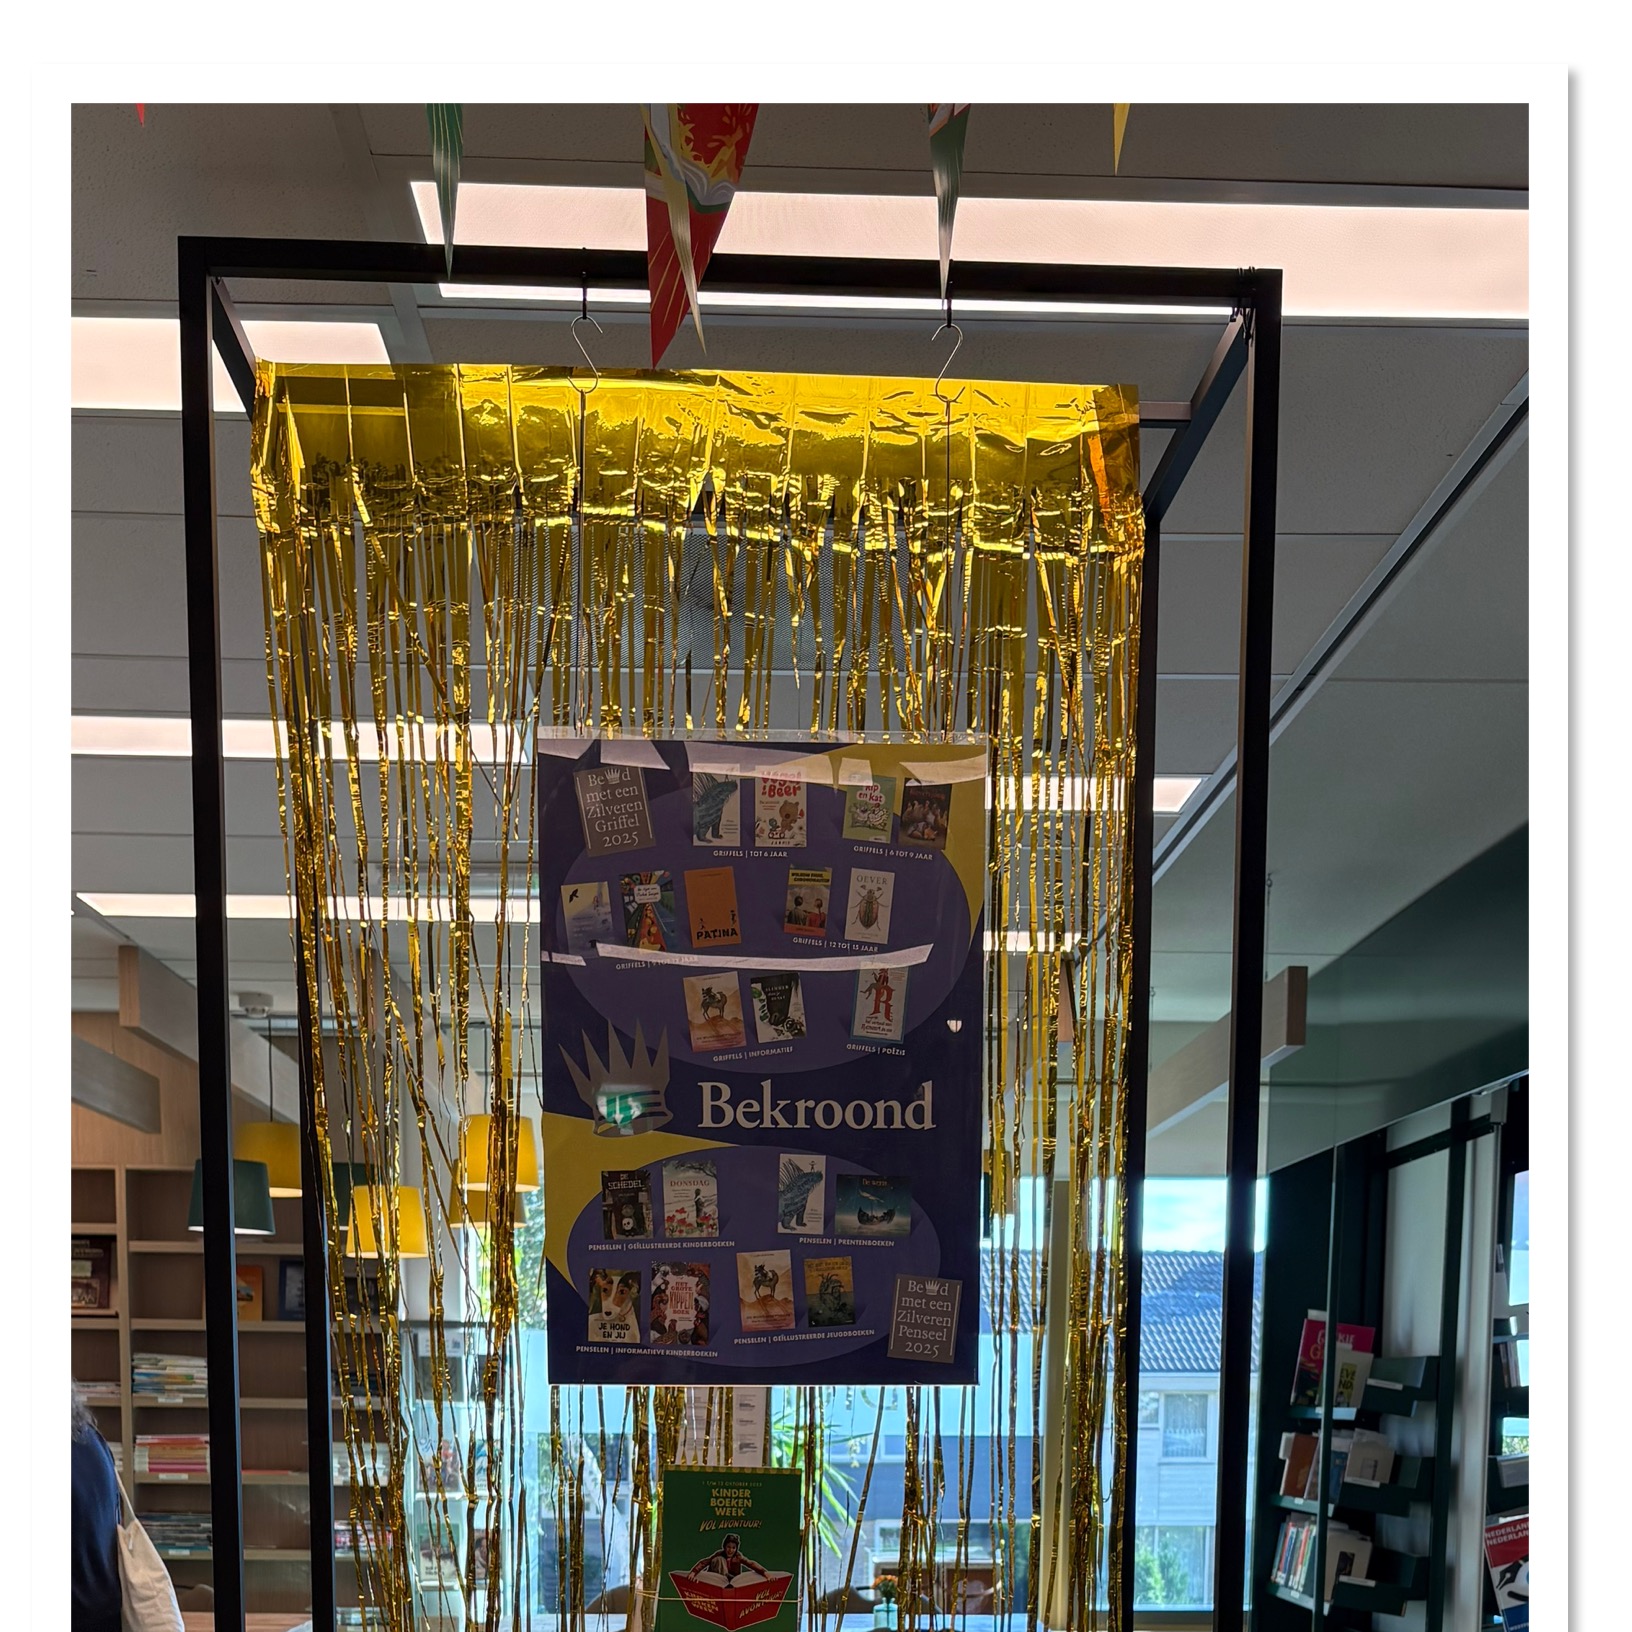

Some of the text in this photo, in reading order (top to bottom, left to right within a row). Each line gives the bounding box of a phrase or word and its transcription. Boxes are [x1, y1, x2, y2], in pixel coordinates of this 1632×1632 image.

[586, 787, 638, 802] met een
[586, 801, 643, 819] Zilveren
[595, 814, 640, 833] Griffel
[604, 832, 639, 848] 2025
[696, 928, 738, 940] PATINA
[713, 1046, 793, 1062] GRIFFELS INFORMATIEF
[697, 1080, 936, 1130] Bekroond
[901, 1296, 951, 1311] met een
[897, 1310, 951, 1326] Zilveren
[898, 1325, 947, 1341] Penseel
[906, 1342, 939, 1359] 2025
[712, 1488, 751, 1498] KINDER
[710, 1498, 752, 1507] BOEKEN
[715, 1508, 745, 1516] WEEK
[700, 1520, 762, 1532] VOL AVONTUUR!
